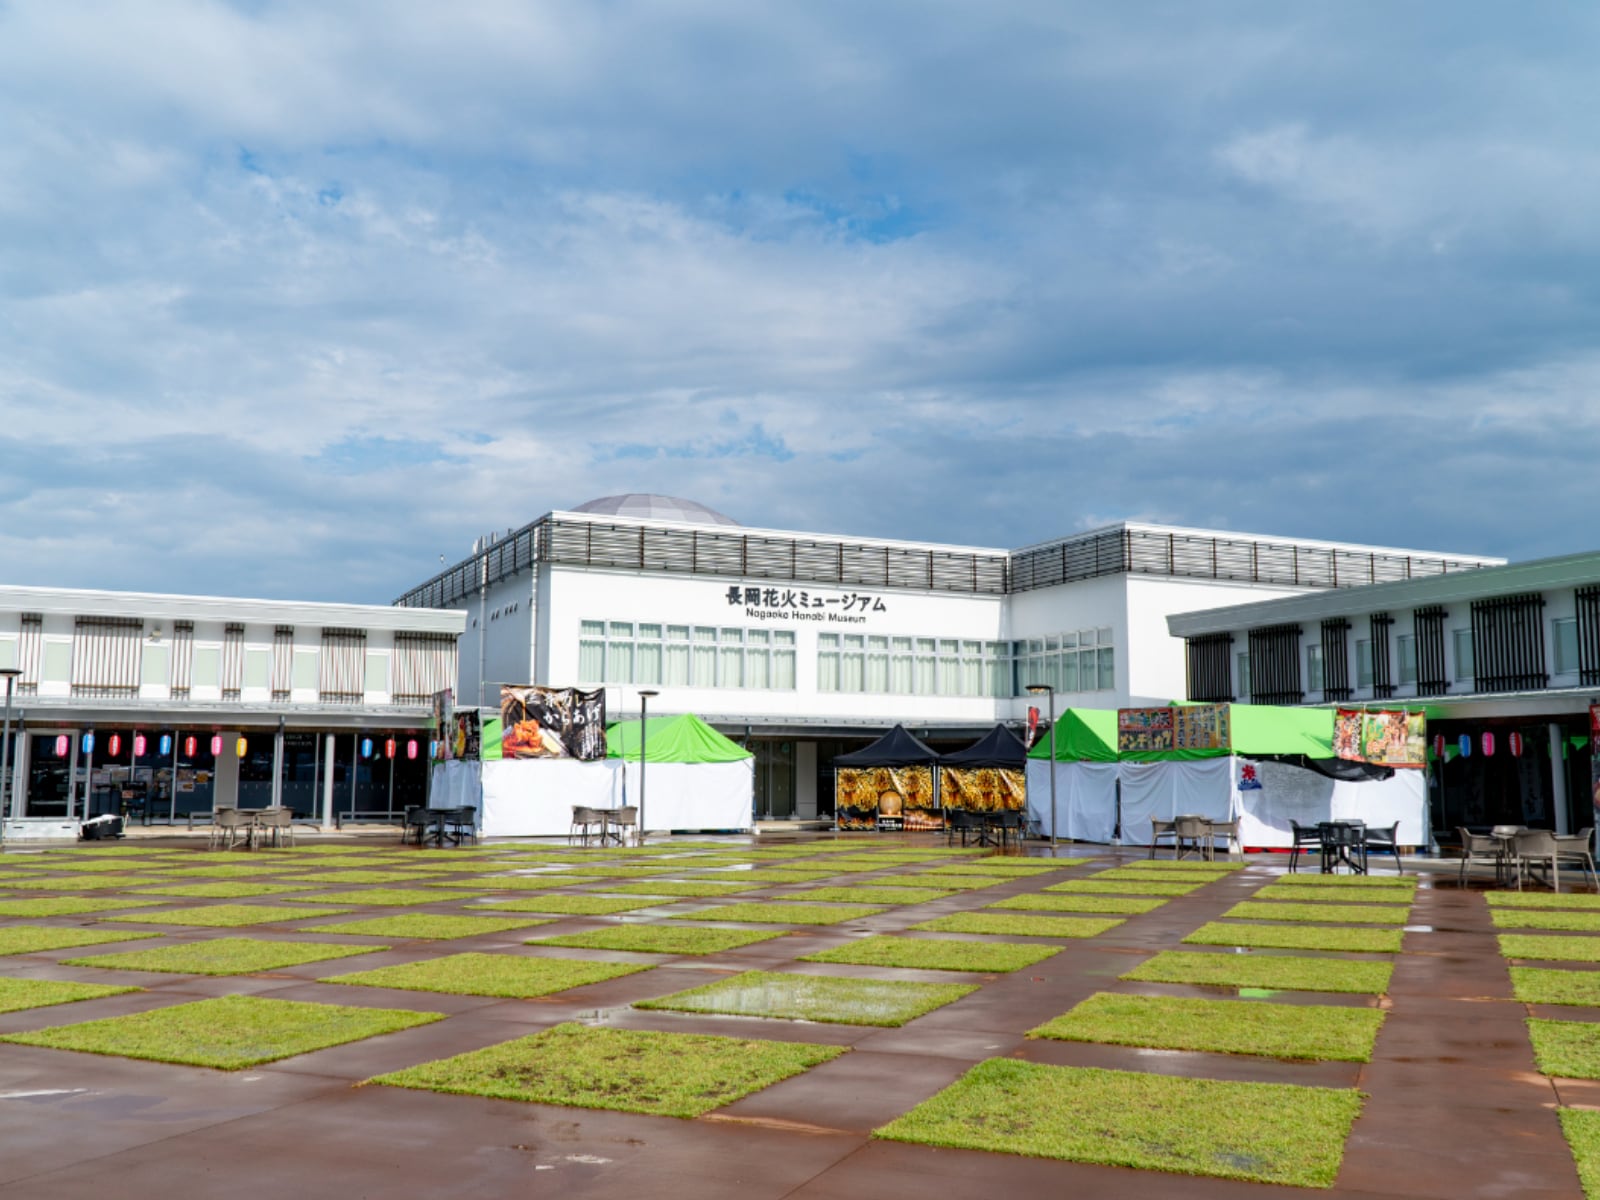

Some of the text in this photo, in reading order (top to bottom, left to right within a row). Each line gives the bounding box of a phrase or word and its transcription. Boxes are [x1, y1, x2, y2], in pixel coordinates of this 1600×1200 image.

[725, 586, 887, 612] 長岡花火ミュージアム
[746, 608, 866, 623] Nagaoka Hanabi Museum
[543, 703, 601, 726] からあげ
[1241, 764, 1256, 781] 氷
